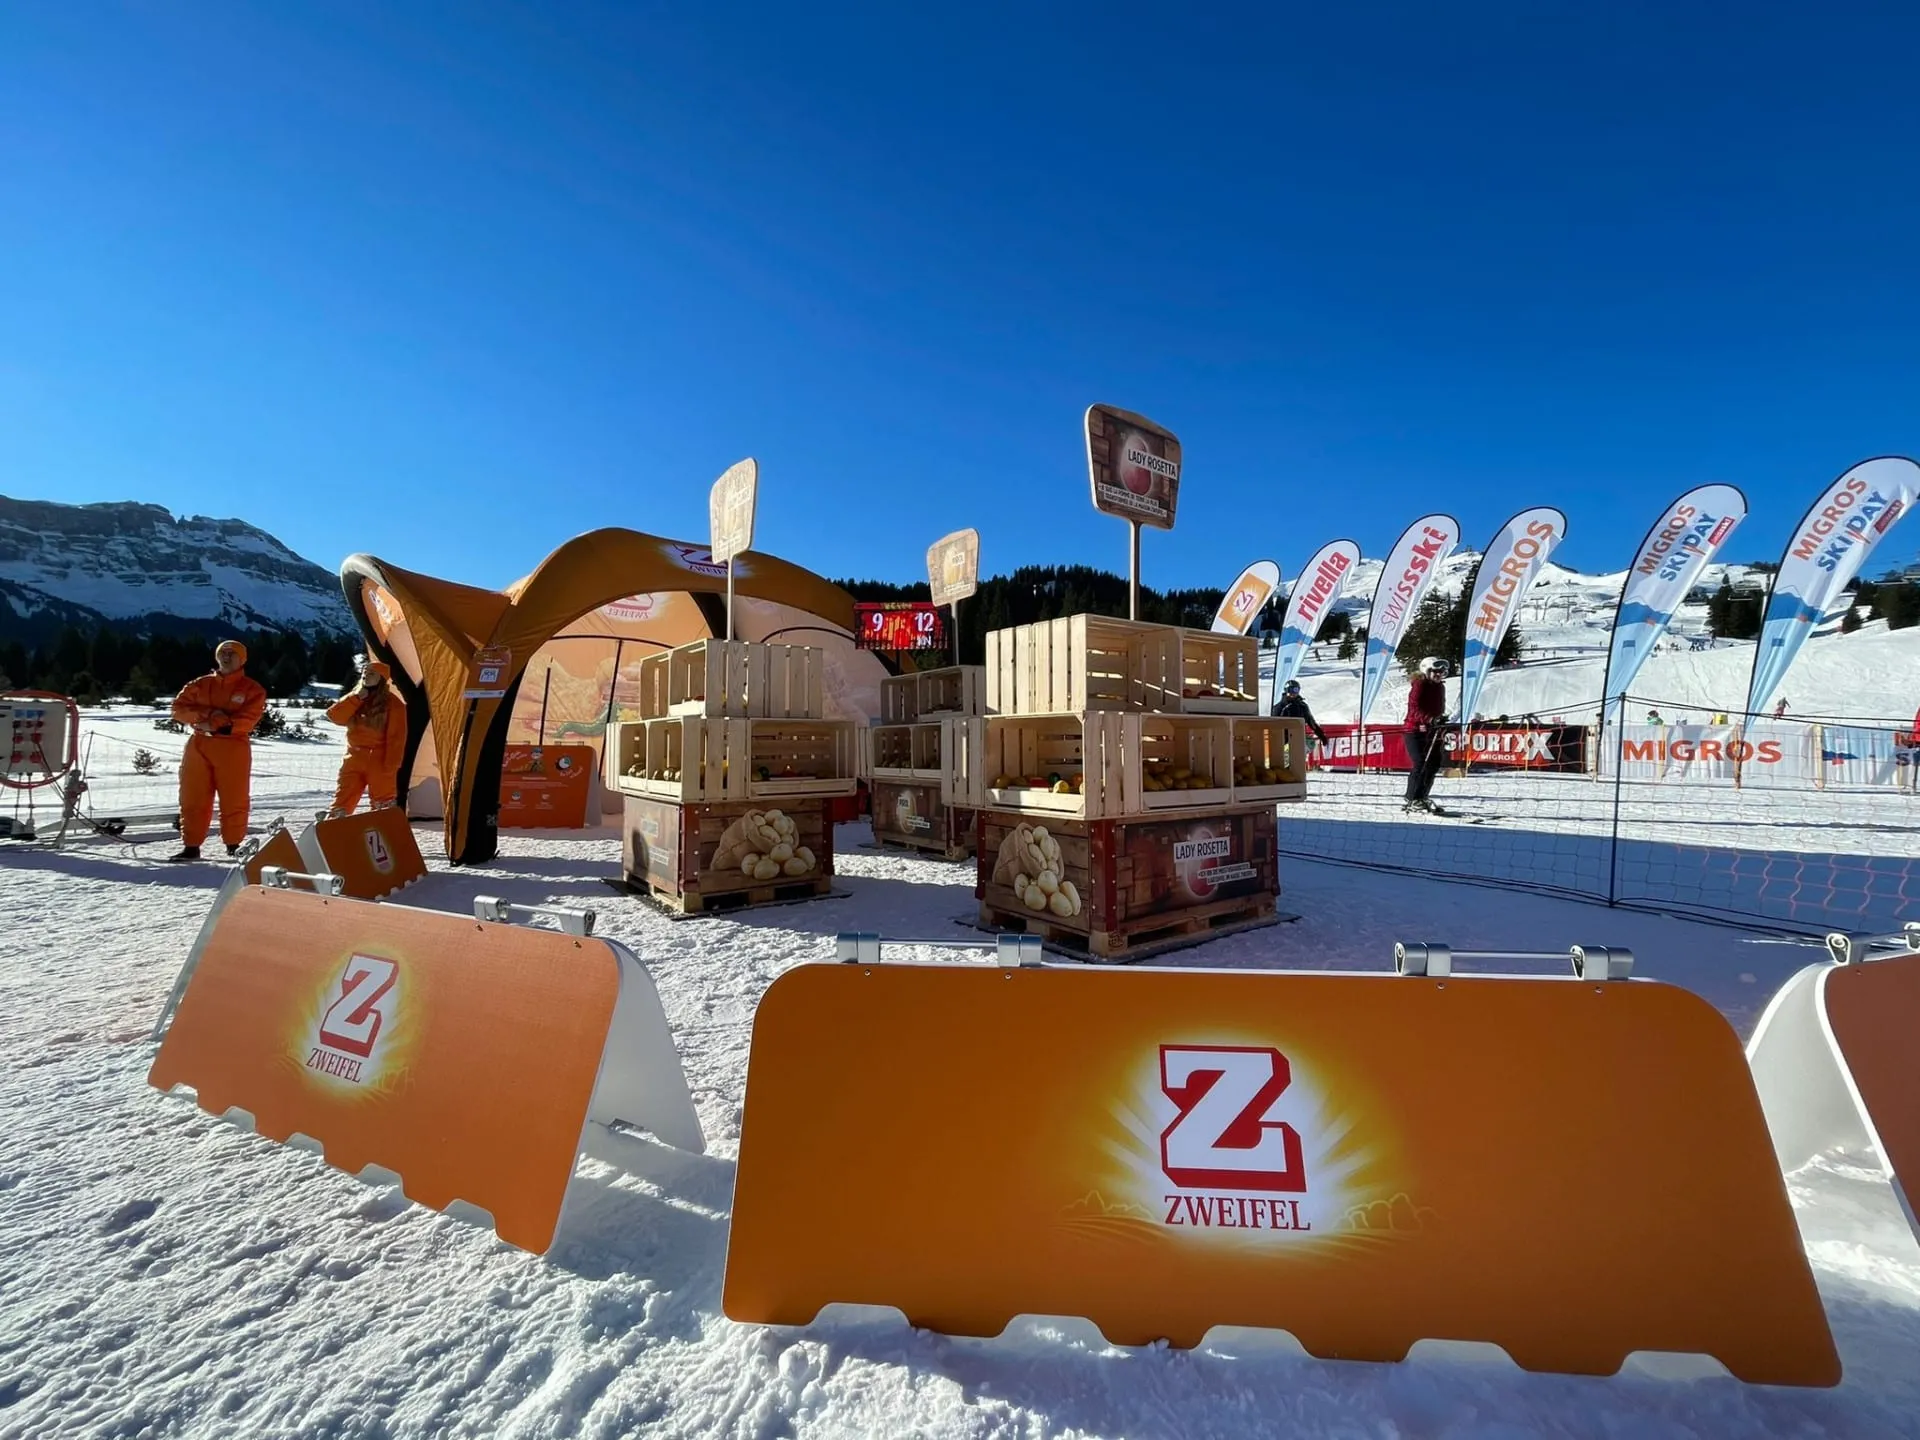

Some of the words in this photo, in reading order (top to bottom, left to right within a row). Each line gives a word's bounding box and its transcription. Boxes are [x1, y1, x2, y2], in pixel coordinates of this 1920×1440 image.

[1127, 449, 1147, 466] LADY
[1147, 456, 1177, 477] ROSETTA
[1792, 477, 1868, 560] MIGROS
[1637, 504, 1696, 575] MIGROS
[1297, 551, 1351, 622] rivella
[1474, 519, 1554, 632] MIGROS
[914, 612, 935, 632] 12
[1480, 753, 1516, 761] MIGROS
[1622, 739, 1783, 764] MIGROS
[1175, 843, 1197, 859] LADY
[1197, 839, 1229, 857] ROSETTA
[305, 1047, 363, 1083] ZWEIFEL
[1164, 1195, 1311, 1231] ZWEIFEL
